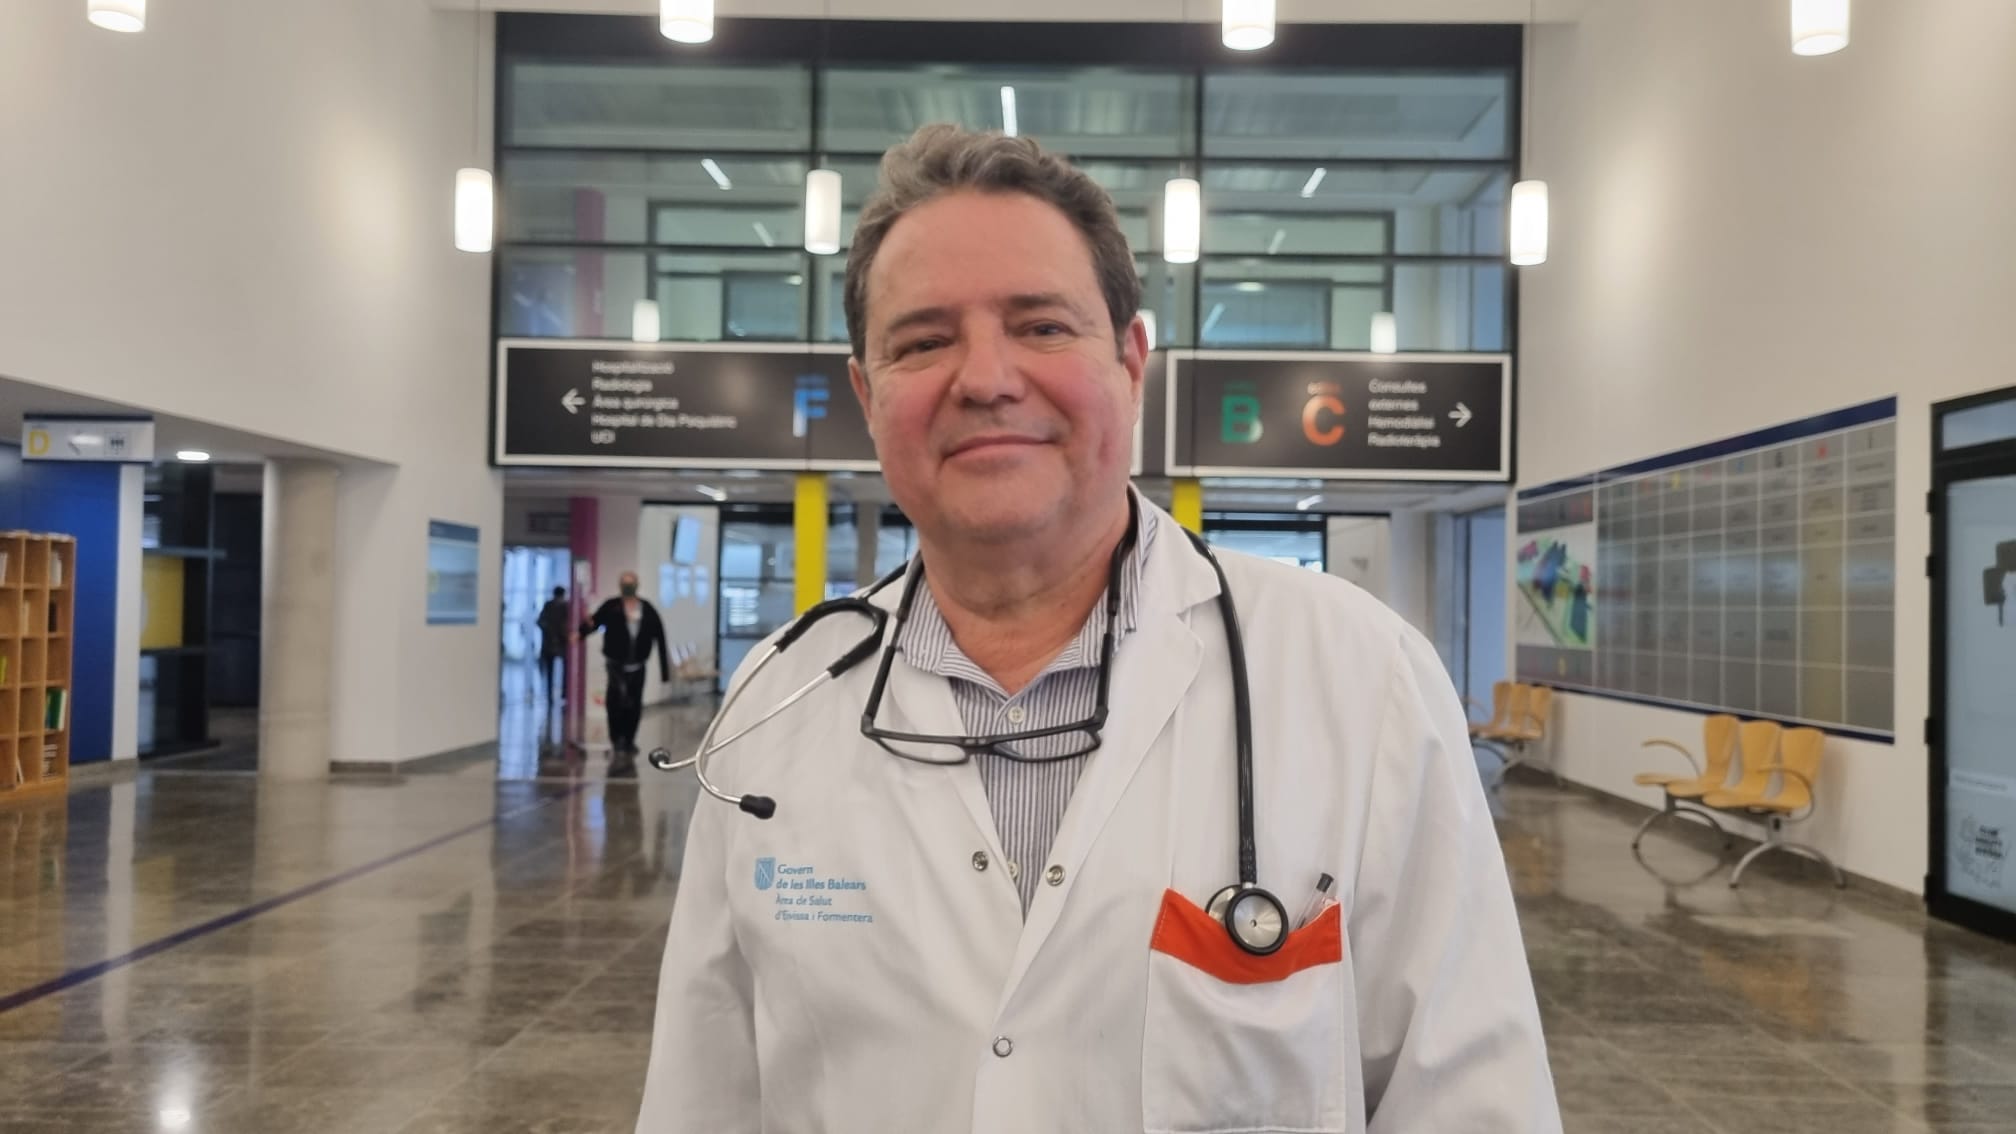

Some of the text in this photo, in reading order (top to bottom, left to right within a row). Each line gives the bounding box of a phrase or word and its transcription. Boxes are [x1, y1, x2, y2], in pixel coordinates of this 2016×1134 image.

[1368, 378, 1427, 394] Consultes
[793, 387, 829, 437] F
[1221, 394, 1263, 443] B
[1302, 394, 1346, 446] C
[28, 429, 50, 456] D
[777, 864, 813, 875] Govern
[776, 878, 866, 891] de les Illes Balears
[796, 896, 807, 905] de
[809, 896, 832, 906] Salut
[817, 911, 873, 923] Formentera
